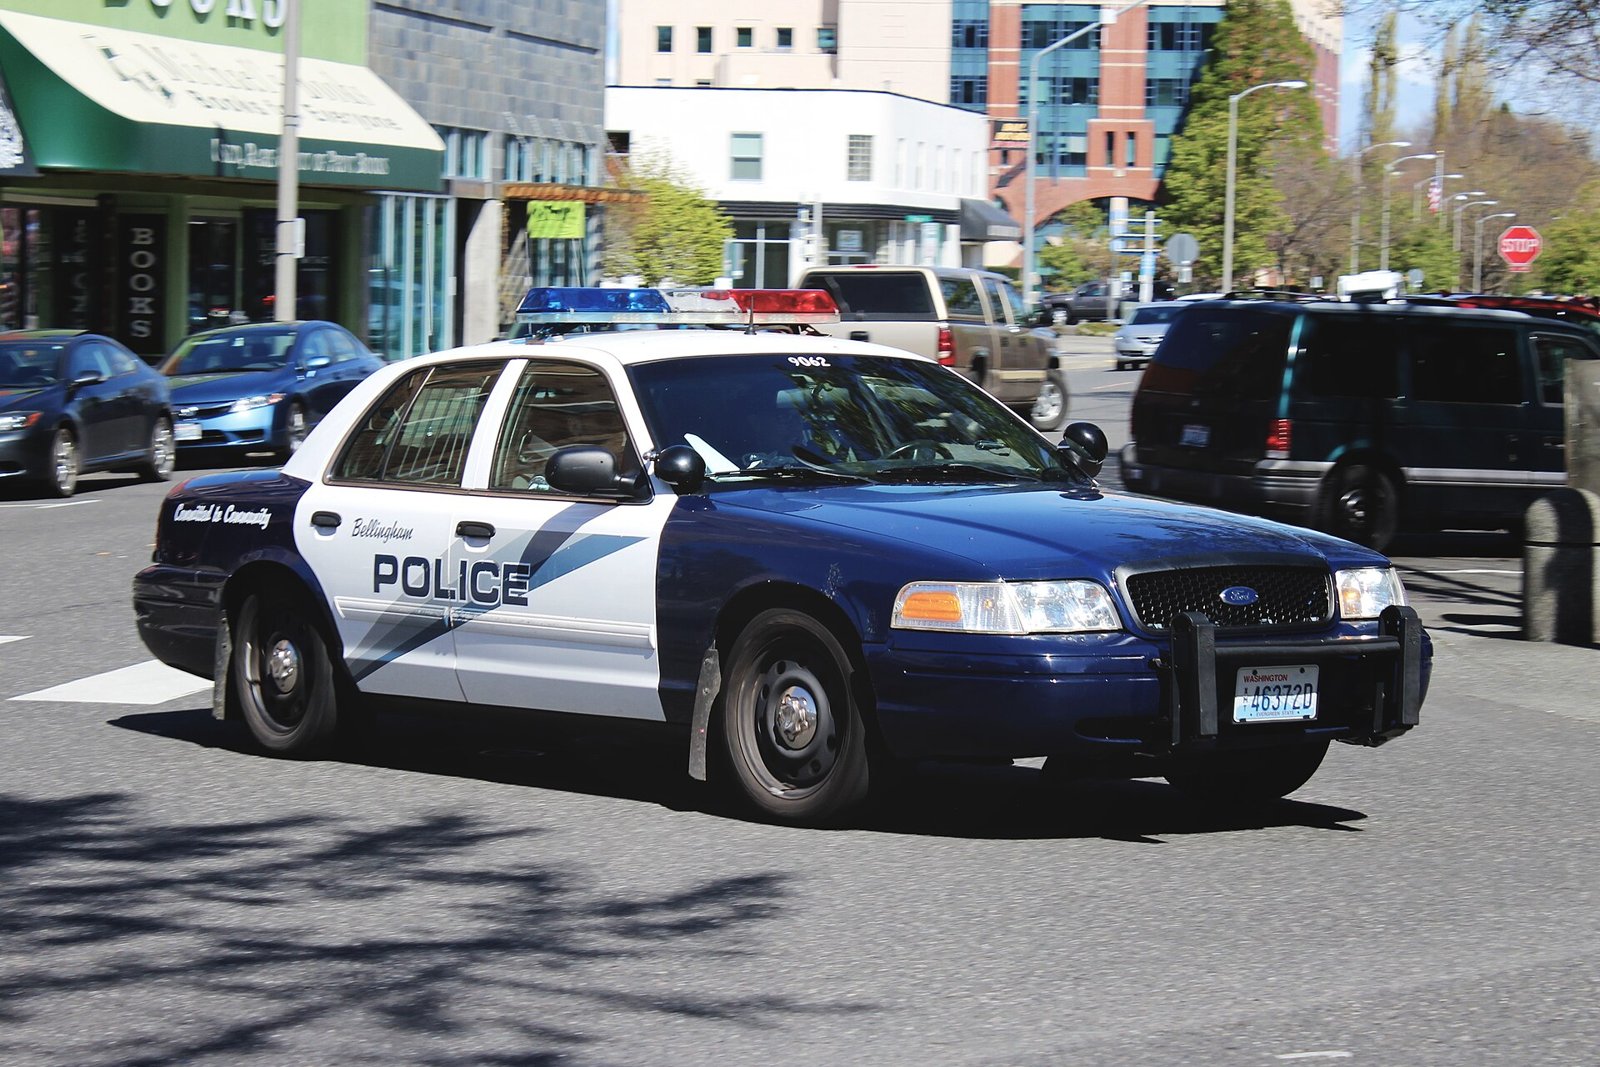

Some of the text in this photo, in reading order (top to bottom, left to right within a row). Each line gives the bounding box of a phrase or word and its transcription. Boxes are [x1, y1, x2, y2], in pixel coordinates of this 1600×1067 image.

[1501, 238, 1539, 252] STOP
[130, 227, 156, 338] BOOKS
[787, 356, 832, 367] 9062
[352, 517, 414, 544] Bellingham
[373, 553, 531, 607] POLICE
[1243, 674, 1289, 683] WASHINGTON
[1251, 682, 1313, 712] 46372D
